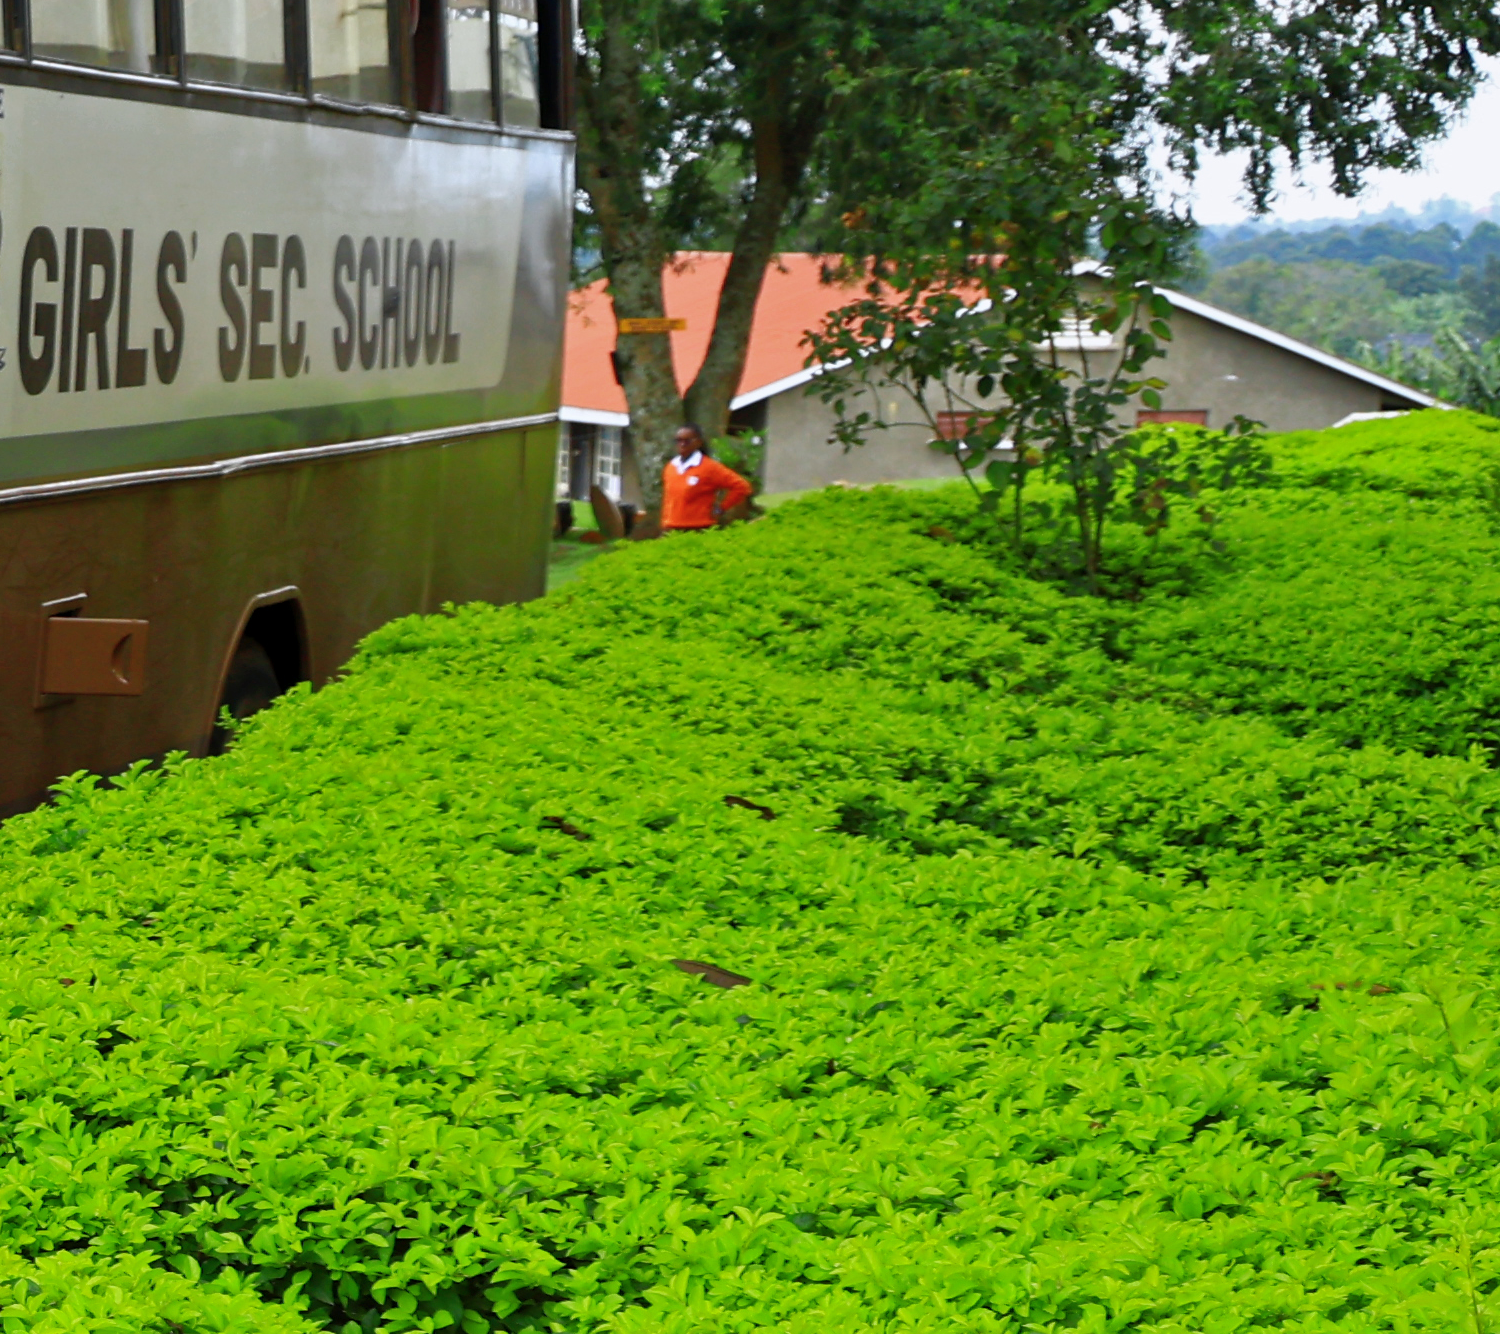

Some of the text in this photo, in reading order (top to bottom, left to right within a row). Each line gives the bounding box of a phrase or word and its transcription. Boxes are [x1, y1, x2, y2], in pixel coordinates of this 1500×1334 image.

[17, 226, 460, 396] GIRLS' SEC. SCHOOL
